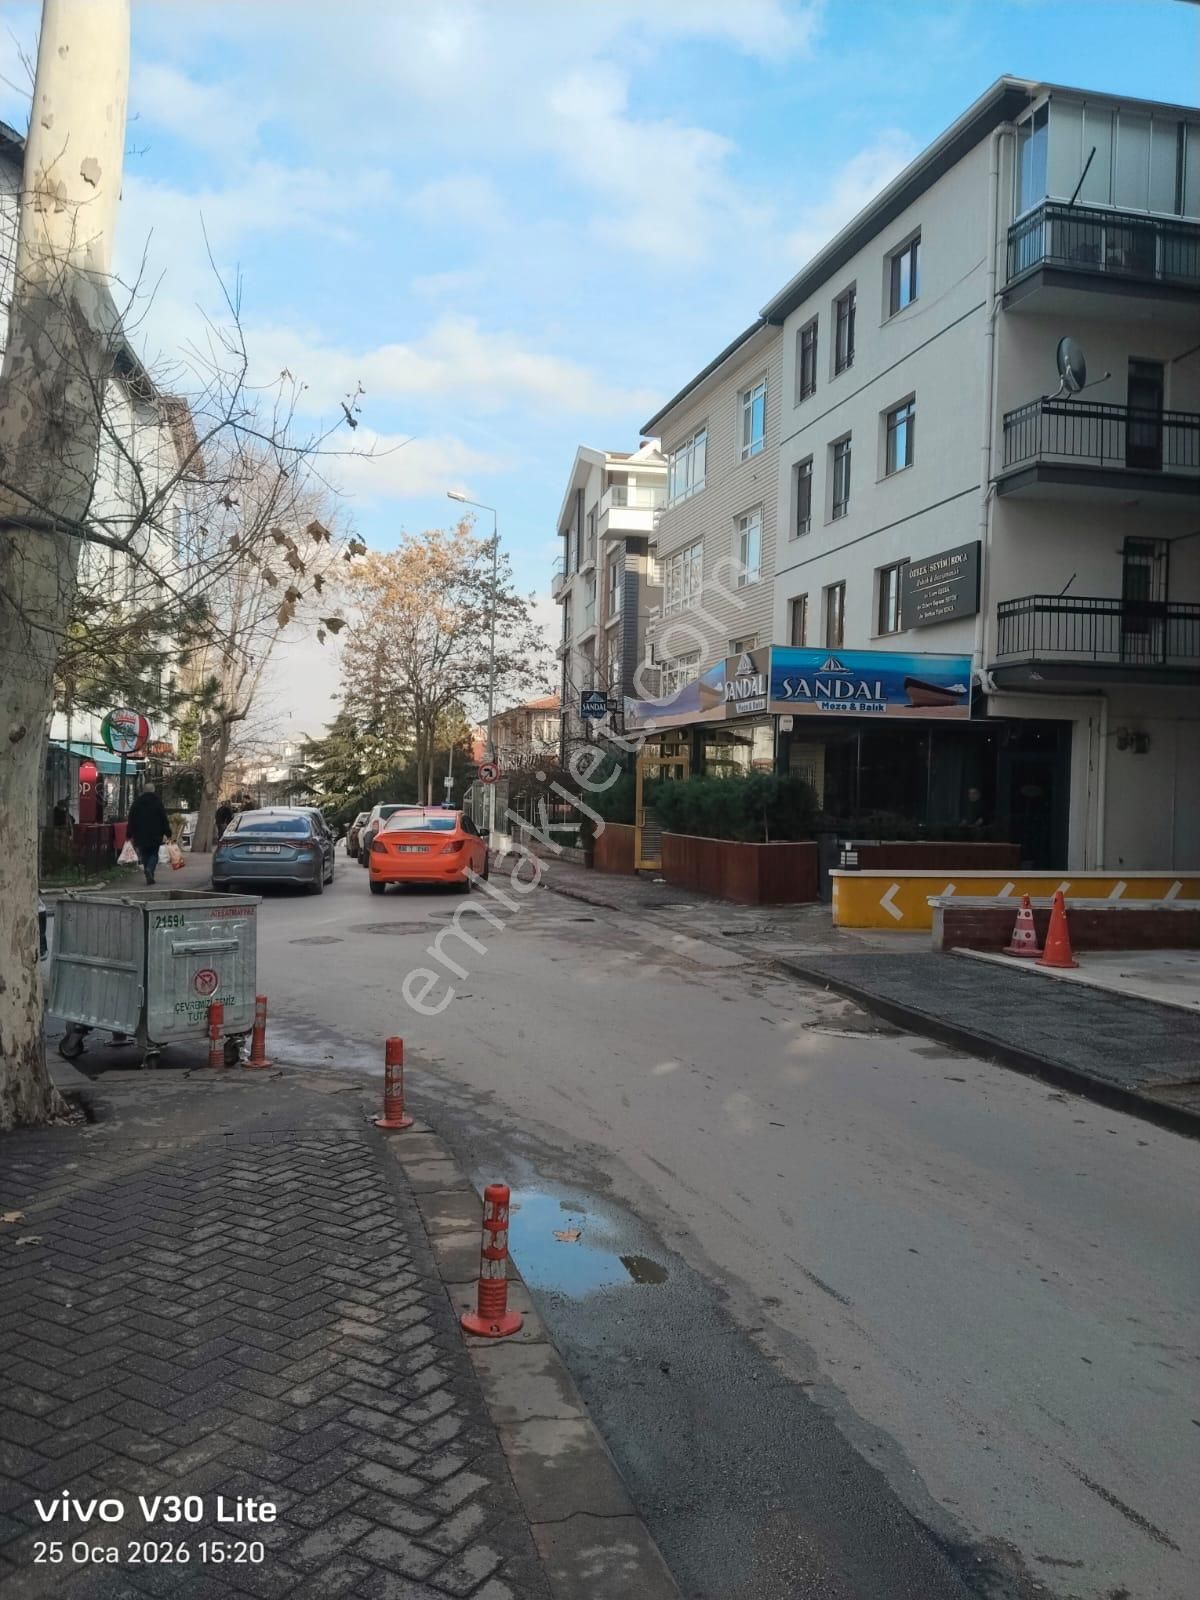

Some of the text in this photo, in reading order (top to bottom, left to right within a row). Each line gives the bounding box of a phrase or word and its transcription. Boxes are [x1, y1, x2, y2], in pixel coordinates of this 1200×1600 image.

[722, 674, 766, 702] SANDAL
[781, 678, 887, 700] SANDAL
[582, 703, 607, 711] SANDAL
[849, 702, 857, 711] &
